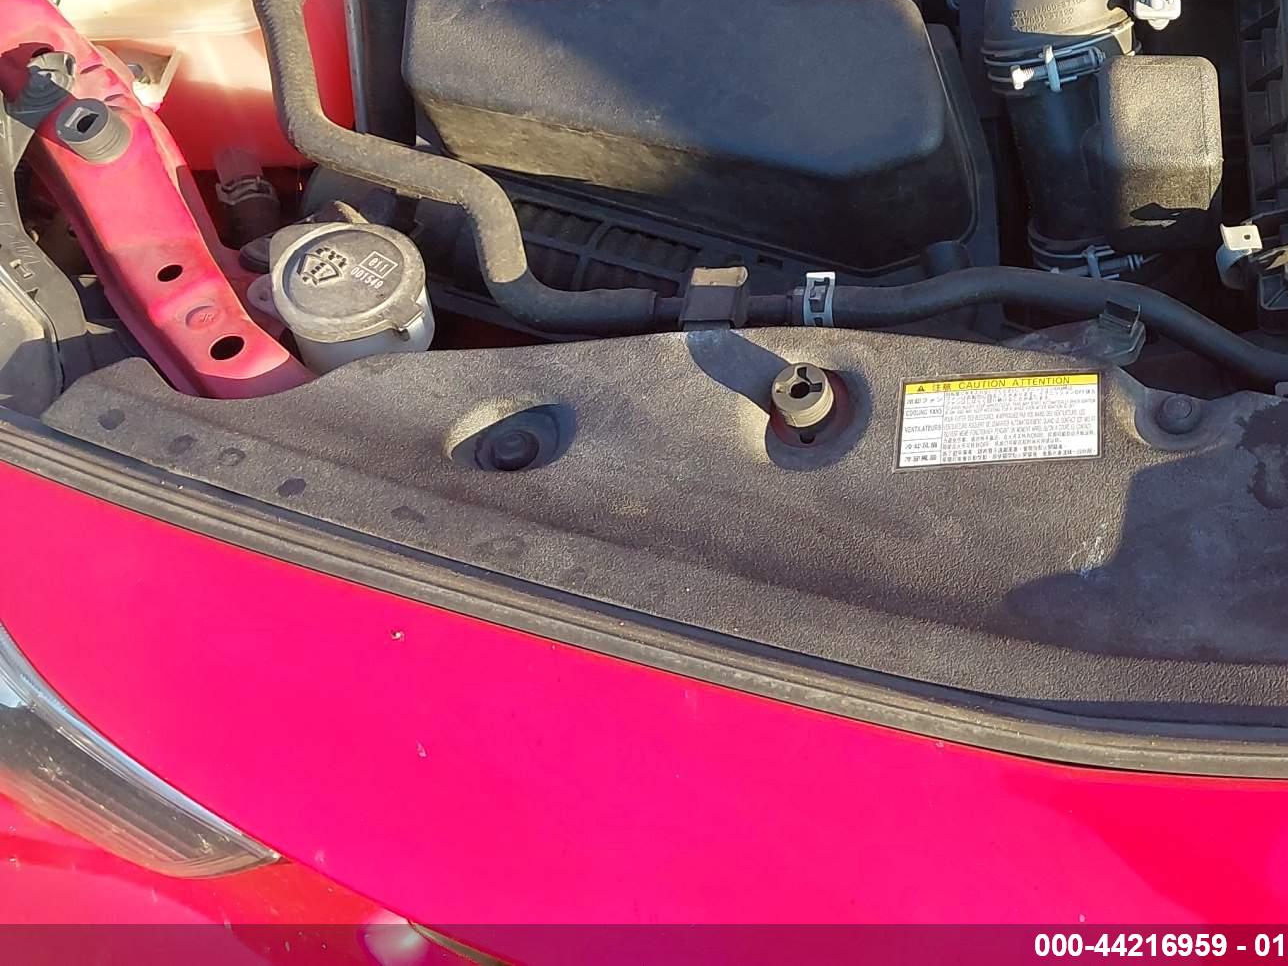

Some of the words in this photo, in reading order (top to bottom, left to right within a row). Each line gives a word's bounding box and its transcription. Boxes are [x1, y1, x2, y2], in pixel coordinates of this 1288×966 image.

[350, 266, 384, 289] 001549
[958, 380, 1006, 390] CAUTION
[1012, 376, 1071, 386] ATTENTION
